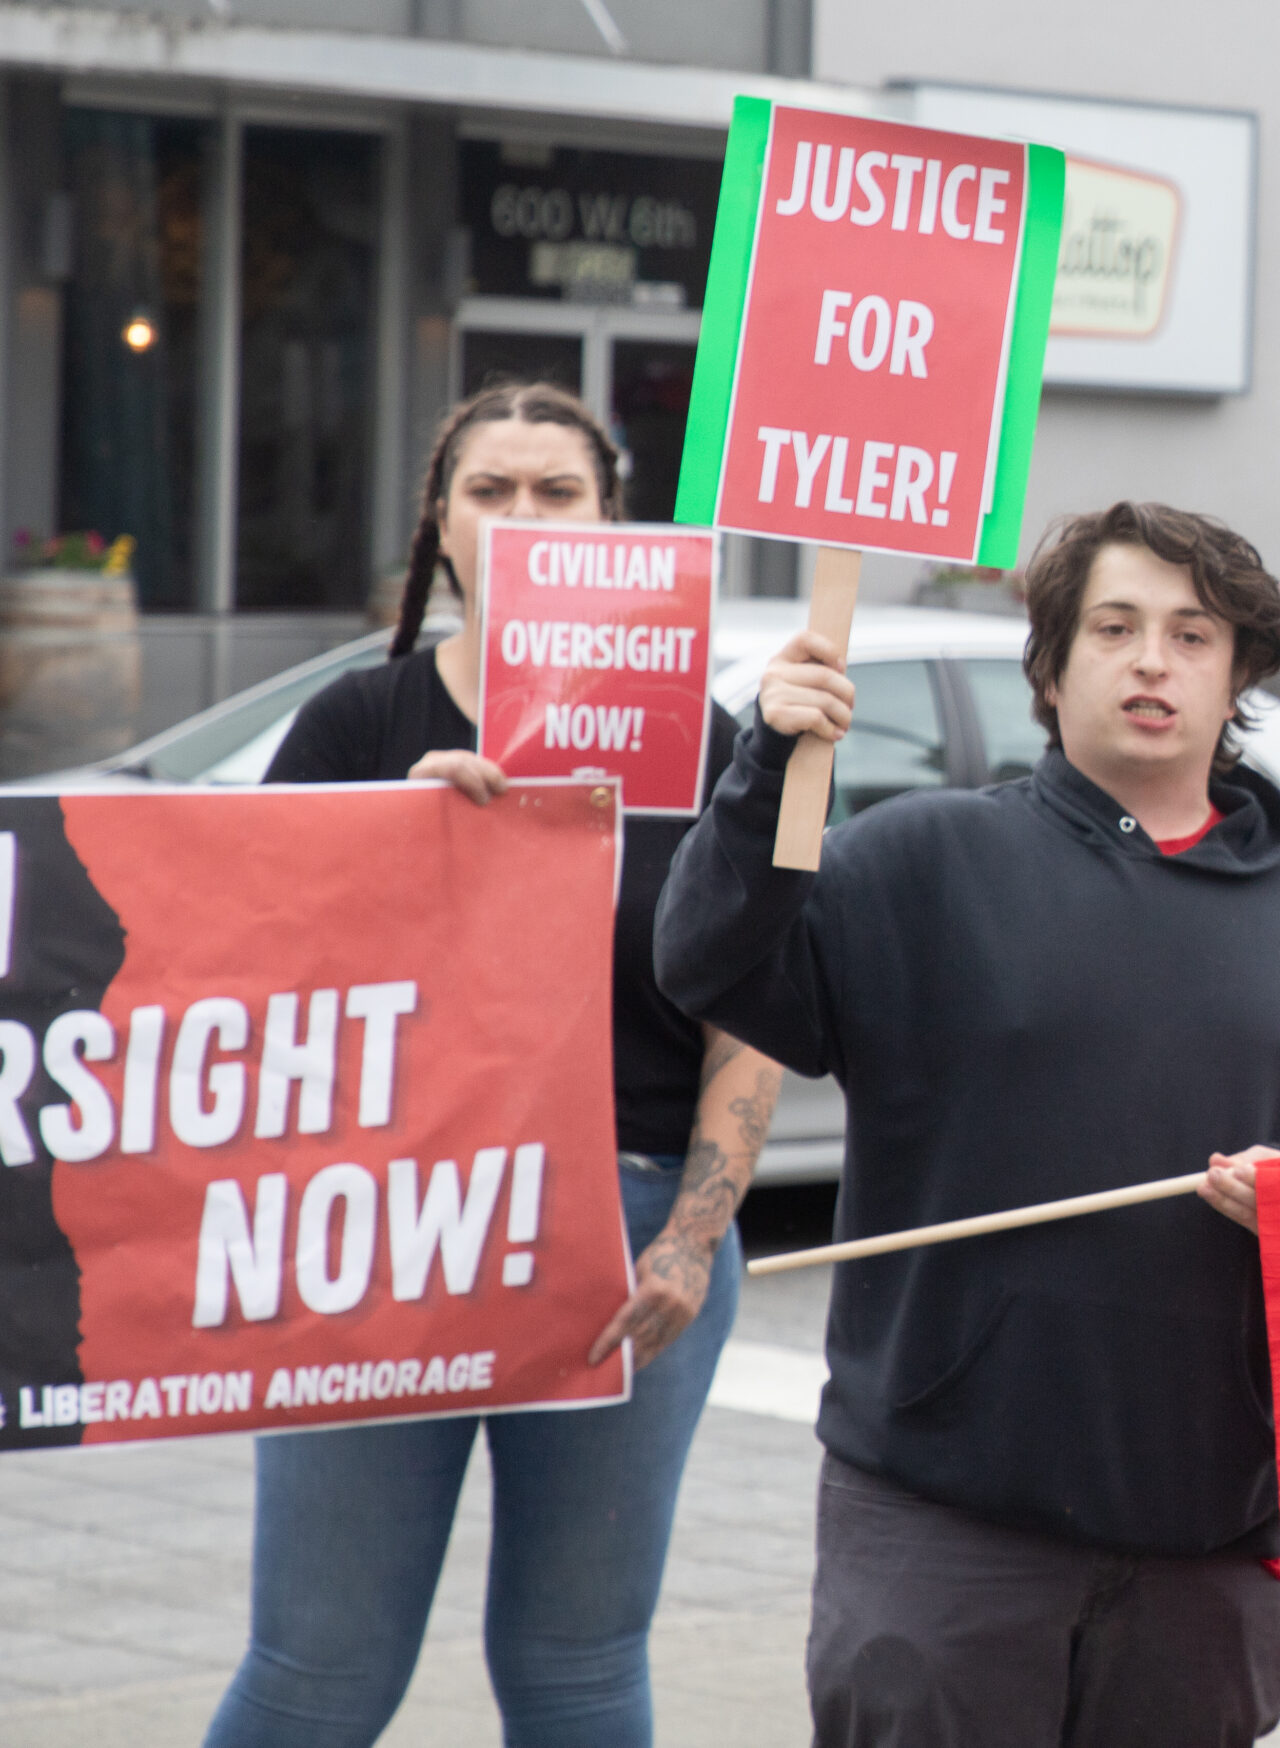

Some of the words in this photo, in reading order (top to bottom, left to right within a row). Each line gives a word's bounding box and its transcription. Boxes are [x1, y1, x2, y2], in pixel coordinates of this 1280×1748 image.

[491, 184, 574, 241] 600
[631, 196, 697, 249] 6th
[775, 140, 1011, 245] JUSTICE
[813, 289, 935, 379] FOR
[757, 426, 958, 527] TYLER!
[527, 540, 676, 591] CIVILIAN
[501, 619, 696, 673] OVERSIGHT
[544, 703, 645, 751] NOW!
[191, 1142, 545, 1329] NOW!
[19, 1371, 254, 1429] LIBERATION
[264, 1351, 496, 1409] ANCHORAGE
